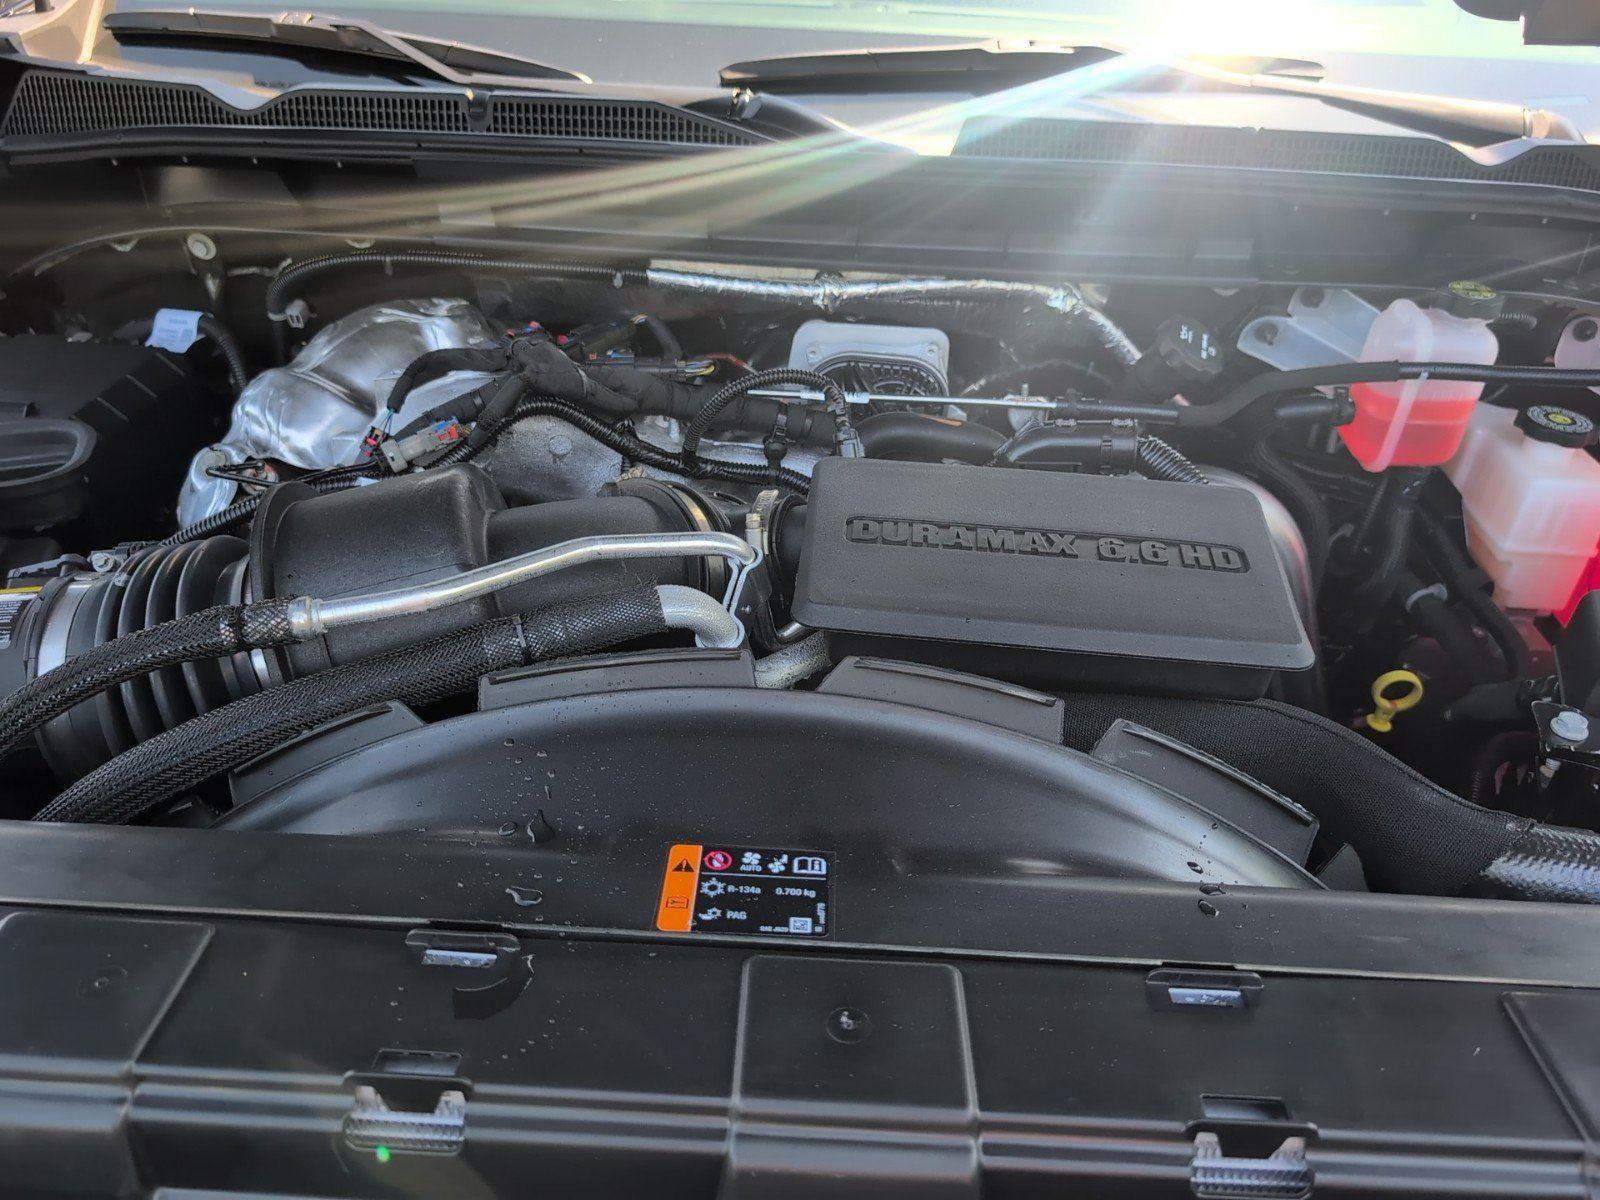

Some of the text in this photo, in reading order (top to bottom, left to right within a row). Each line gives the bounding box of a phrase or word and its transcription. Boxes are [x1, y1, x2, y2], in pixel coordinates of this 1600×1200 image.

[850, 518, 1247, 573] DURAMAX 6.6 HD
[740, 864, 762, 872] AUTO
[727, 884, 762, 894] R-134a
[803, 888, 816, 898] kg
[726, 910, 747, 920] PAG
